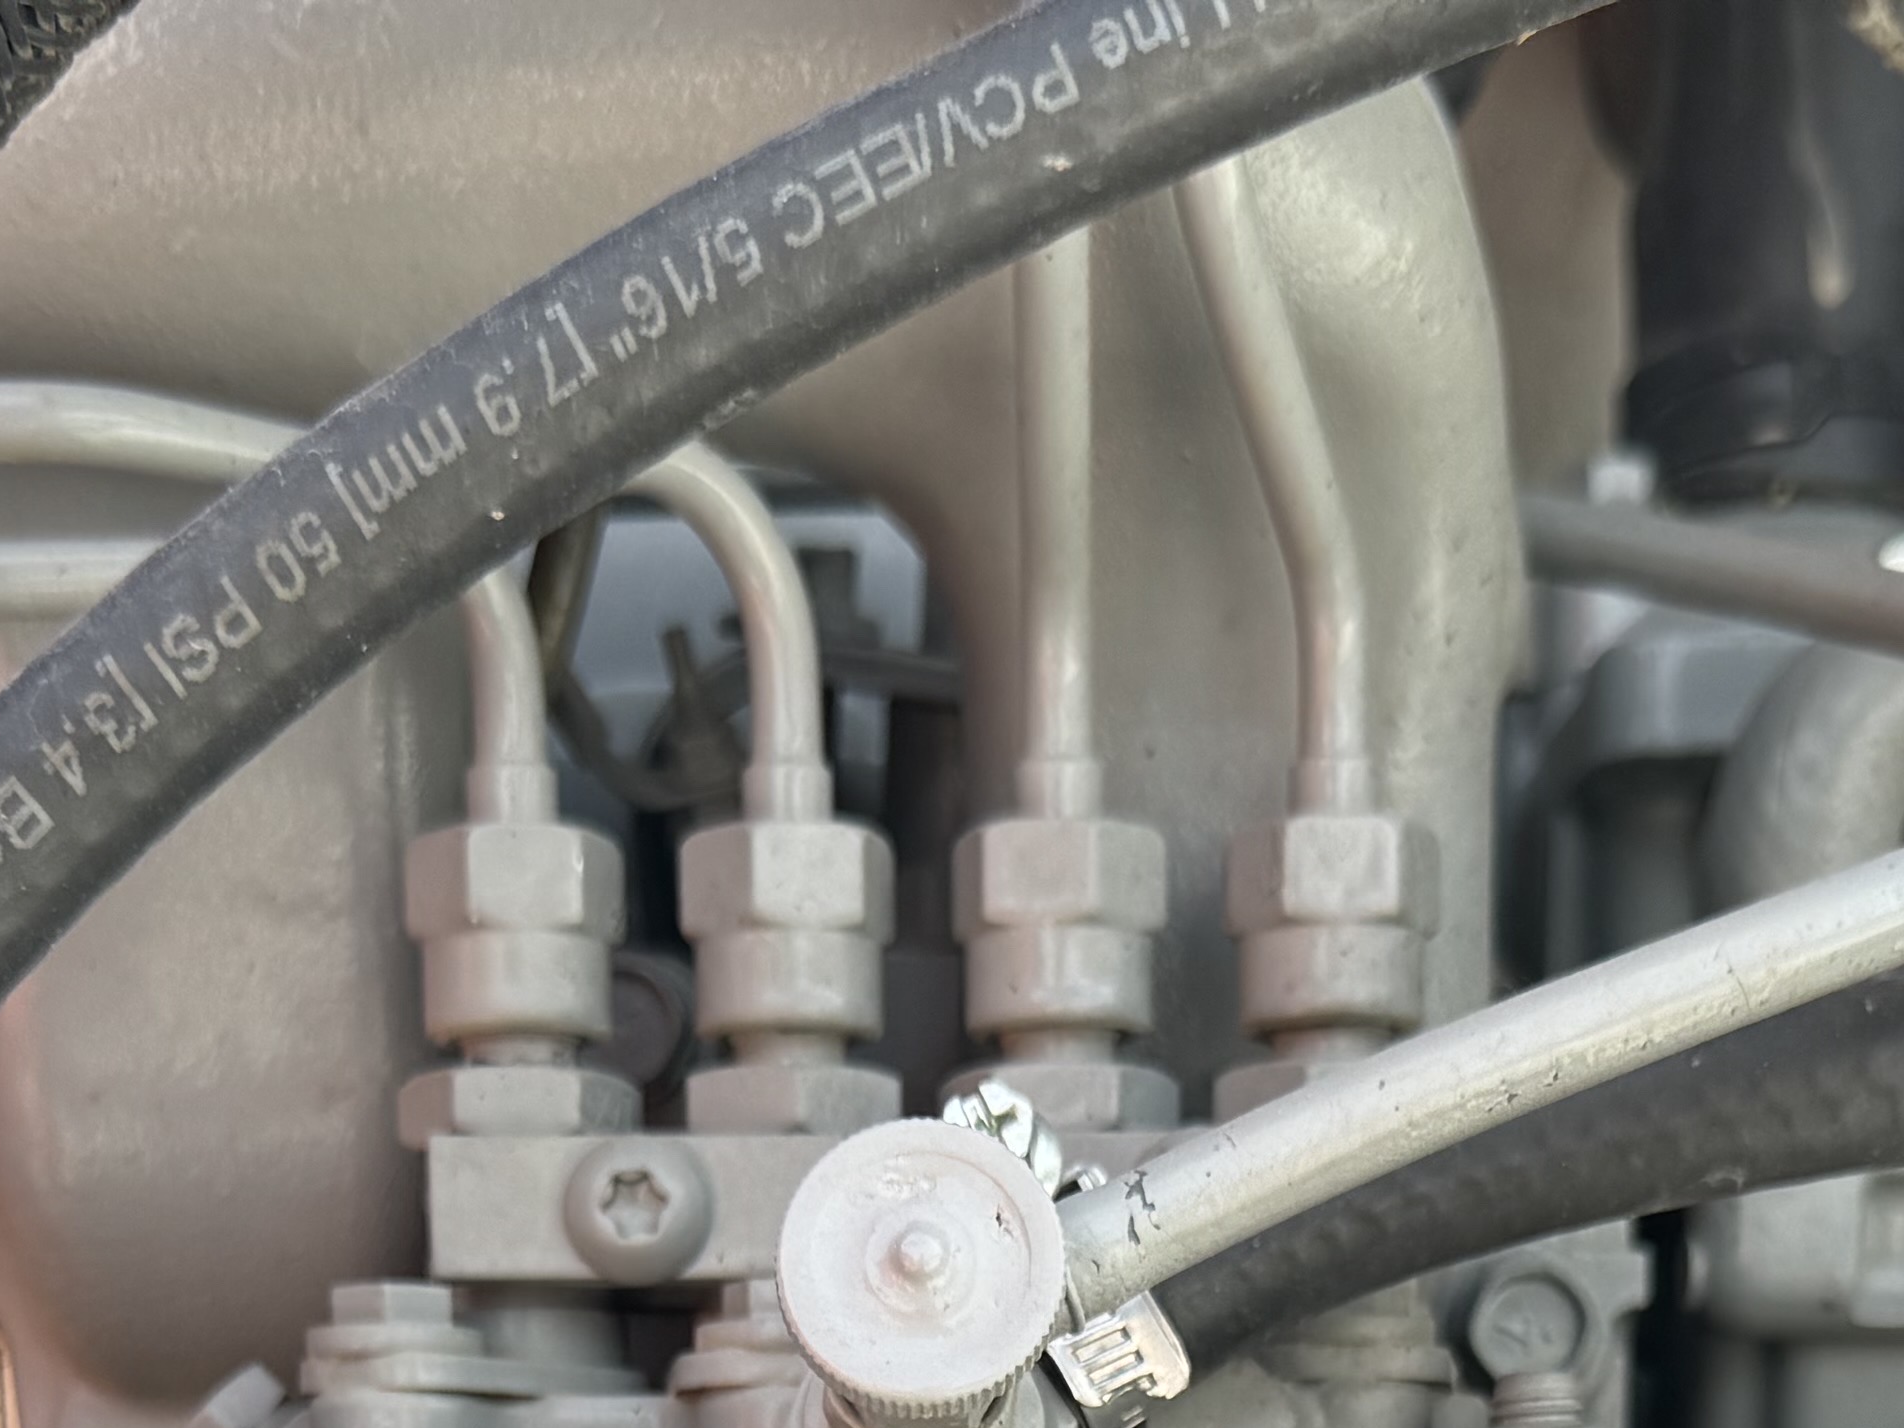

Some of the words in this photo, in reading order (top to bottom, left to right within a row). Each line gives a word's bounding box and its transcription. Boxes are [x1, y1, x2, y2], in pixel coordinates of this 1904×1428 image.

[771, 42, 1082, 250] PCV/EEC
[325, 403, 468, 541] mm]
[254, 509, 343, 605] 50
[144, 573, 264, 700] PSI
[40, 653, 160, 797] [3.4
